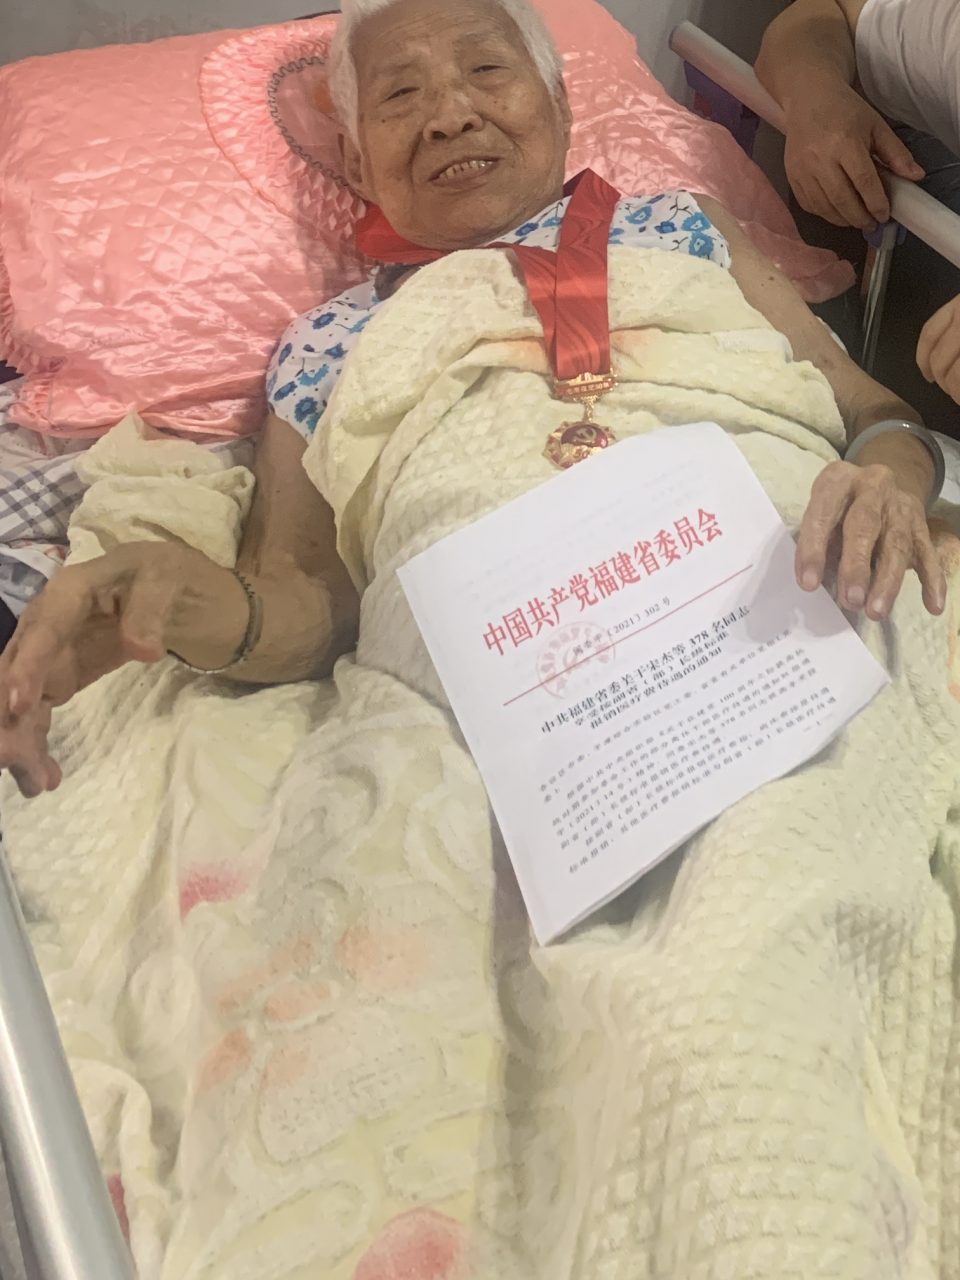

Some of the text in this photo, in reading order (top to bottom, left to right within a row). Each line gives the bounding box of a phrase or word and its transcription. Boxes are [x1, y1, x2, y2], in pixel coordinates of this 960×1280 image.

[483, 508, 723, 656] 中国共产党福建省委员会
